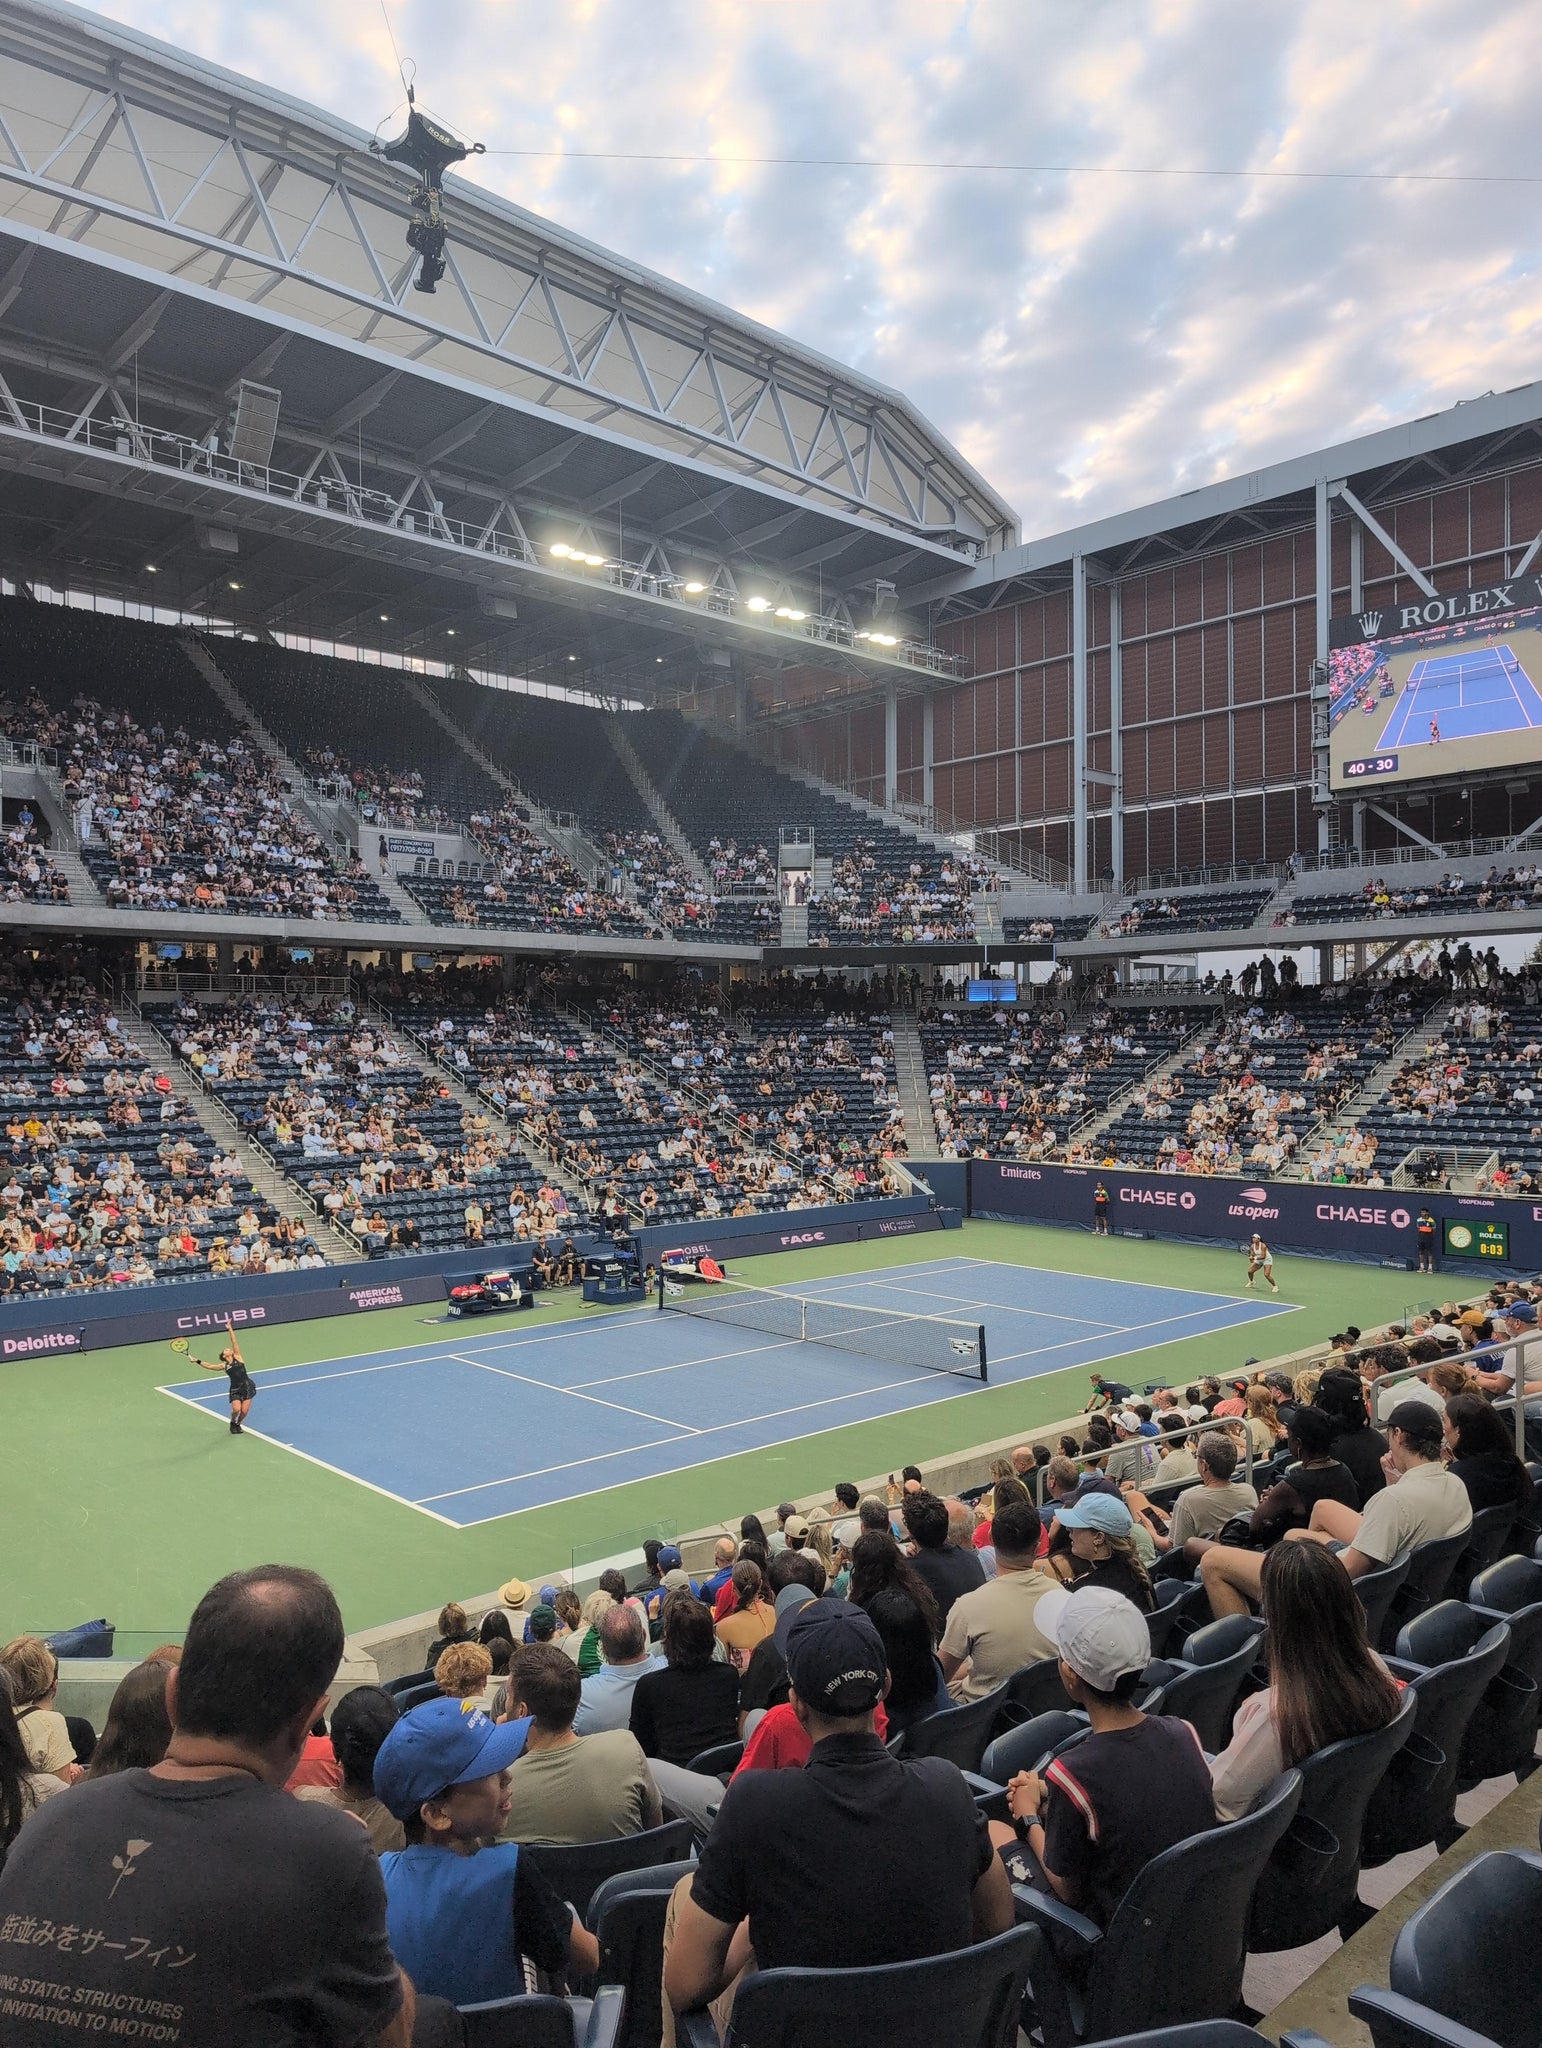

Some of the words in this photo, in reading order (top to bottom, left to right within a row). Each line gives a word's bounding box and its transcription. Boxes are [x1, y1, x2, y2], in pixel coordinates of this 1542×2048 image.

[428, 126, 450, 144] ROSS
[1400, 585, 1515, 629] ROLEX
[1348, 763, 1365, 774] 40
[1376, 759, 1393, 770] 30
[1001, 1166, 1041, 1180] Emirates
[1120, 1188, 1177, 1206] CHASE
[1245, 1207, 1279, 1220] open
[1317, 1204, 1387, 1225] CHASE
[879, 1221, 897, 1232] IHG
[682, 1244, 712, 1255] OBEL
[1480, 1243, 1503, 1255] 0:03
[349, 1286, 401, 1300] AMERICAN
[358, 1294, 403, 1308] EXPRESS
[177, 1307, 266, 1329] CHUBB
[448, 1305, 461, 1316] POLO
[3, 1332, 81, 1354] Deloitte.
[824, 1676, 842, 1696] NEW
[841, 1669, 867, 1682] YORK
[866, 1670, 879, 1684] CITY
[1, 1912, 197, 1968] 街並みをサーフィン
[20, 1978, 71, 2000] STATIC
[73, 1987, 184, 2020] STRUCTURES
[2, 1999, 82, 2027] INVITATION
[85, 2012, 107, 2031] TO
[108, 2017, 181, 2043] MOTION
